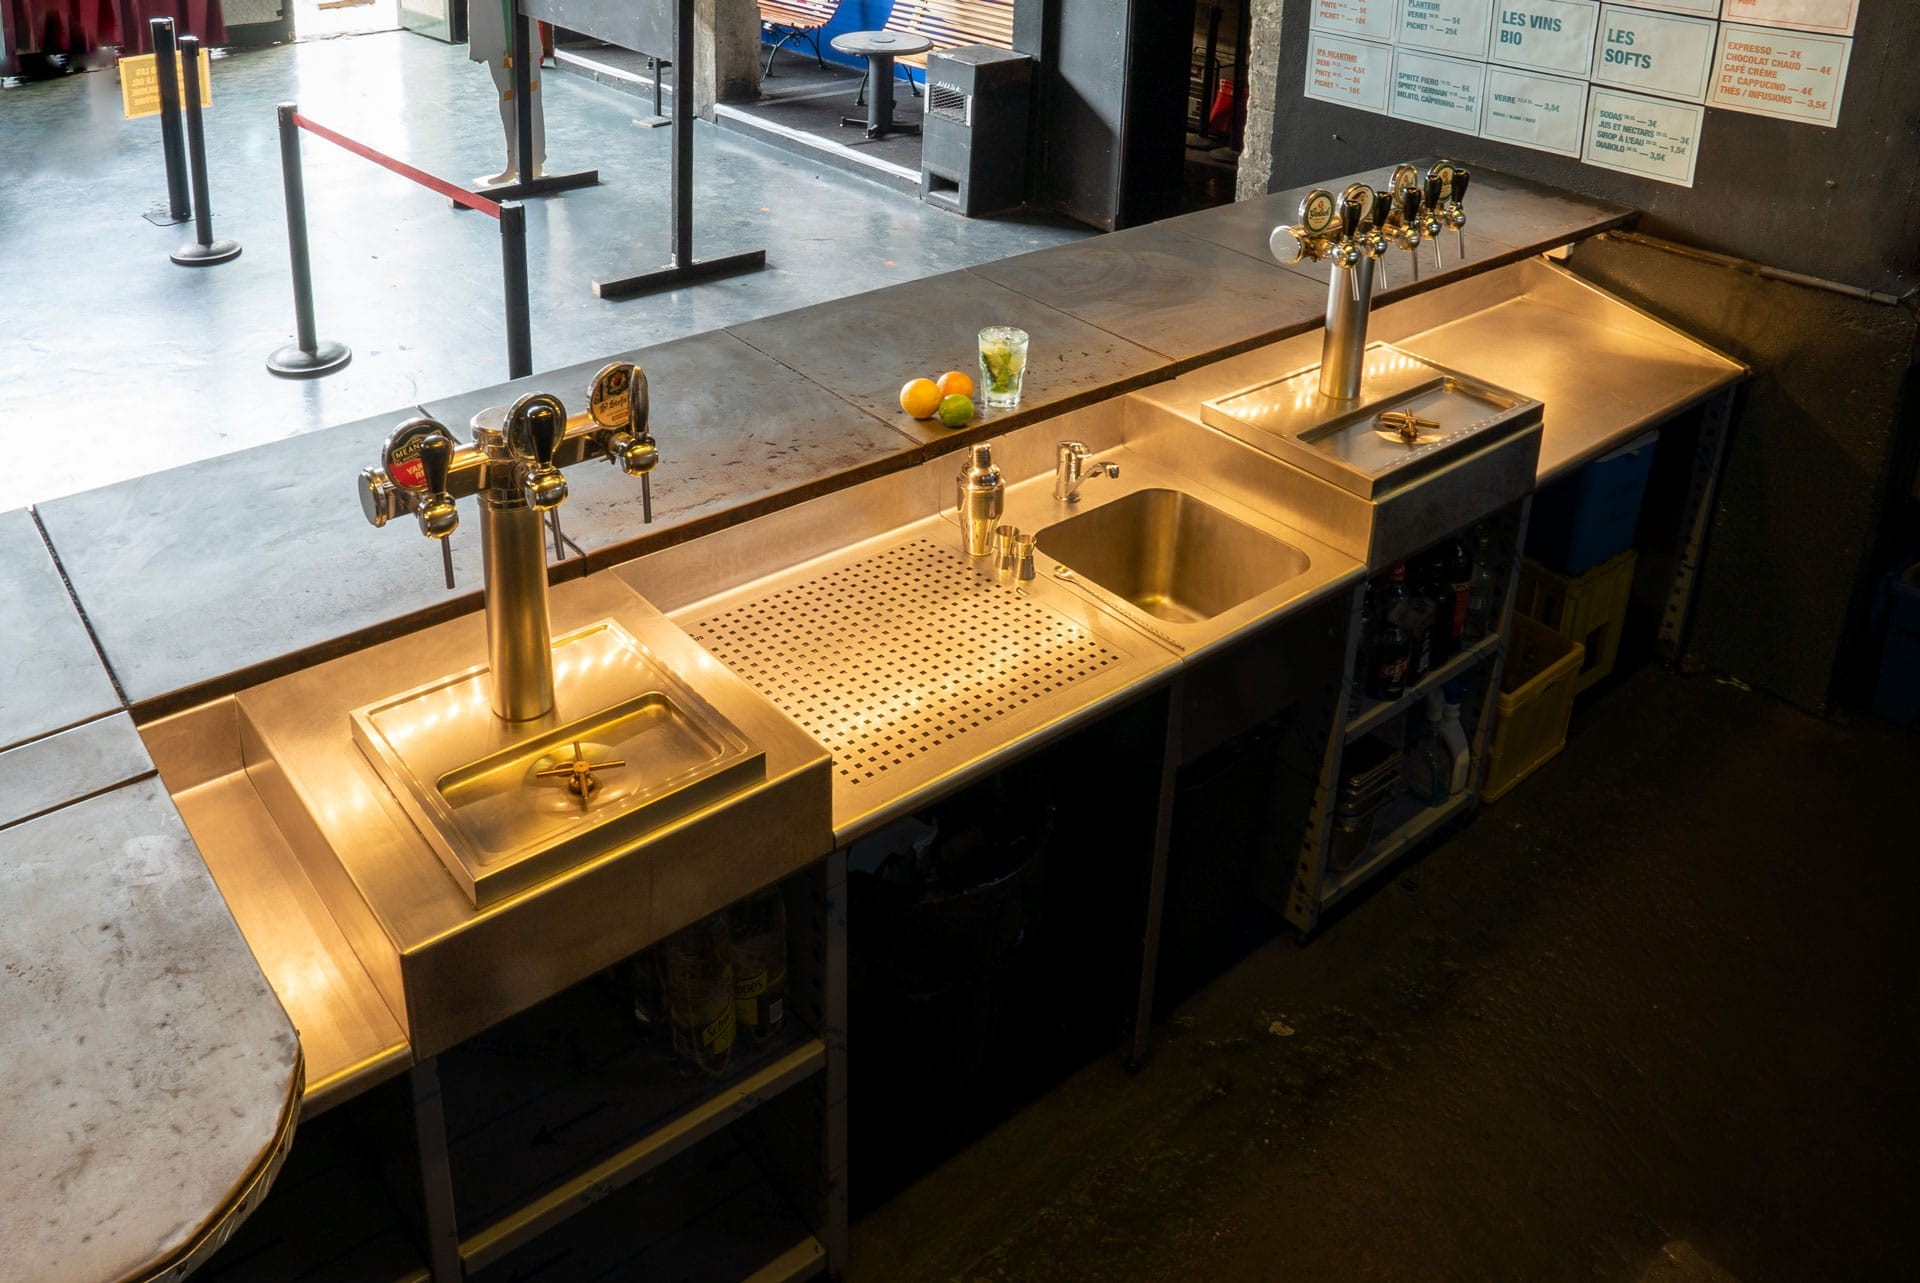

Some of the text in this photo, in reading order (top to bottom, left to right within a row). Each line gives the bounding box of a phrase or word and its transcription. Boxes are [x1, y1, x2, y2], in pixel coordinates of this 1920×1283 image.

[1407, 11, 1427, 19] VERRE
[1502, 11, 1562, 32] LES VINS
[1407, 22, 1428, 31] PICHET
[1501, 30, 1522, 45] BIO
[1608, 28, 1635, 46] LES
[1605, 48, 1651, 69] SOFTS
[1728, 42, 1802, 59] EXPRESSO 2€
[1724, 64, 1745, 74] CAFÉ
[1726, 53, 1832, 75] CHOCOLAT CHAUD 4€
[1398, 82, 1416, 91] SPRITZ
[1399, 73, 1419, 82] SPRITZ
[1722, 75, 1814, 96] ET CAPPUCINO 4€
[1397, 91, 1419, 102] MOJITO,
[1494, 94, 1516, 104] VERRE
[1544, 103, 1560, 112] 3,5€
[1748, 91, 1792, 104] INFUSIONS
[1808, 100, 1828, 110] 3,5€
[1600, 110, 1623, 121] SODAS
[1648, 119, 1657, 128] 3€
[1598, 120, 1612, 130] JUS
[1613, 123, 1622, 131] ET
[1623, 125, 1655, 138] NECTARS
[1680, 136, 1690, 145] 3€
[1596, 140, 1625, 153] DIABOLO
[1650, 152, 1666, 161] 3,5€
[1597, 131, 1617, 142] SIROP
[1625, 137, 1644, 147] L'EAU
[1670, 145, 1687, 155] 1,5€
[395, 443, 421, 458] MEAN
